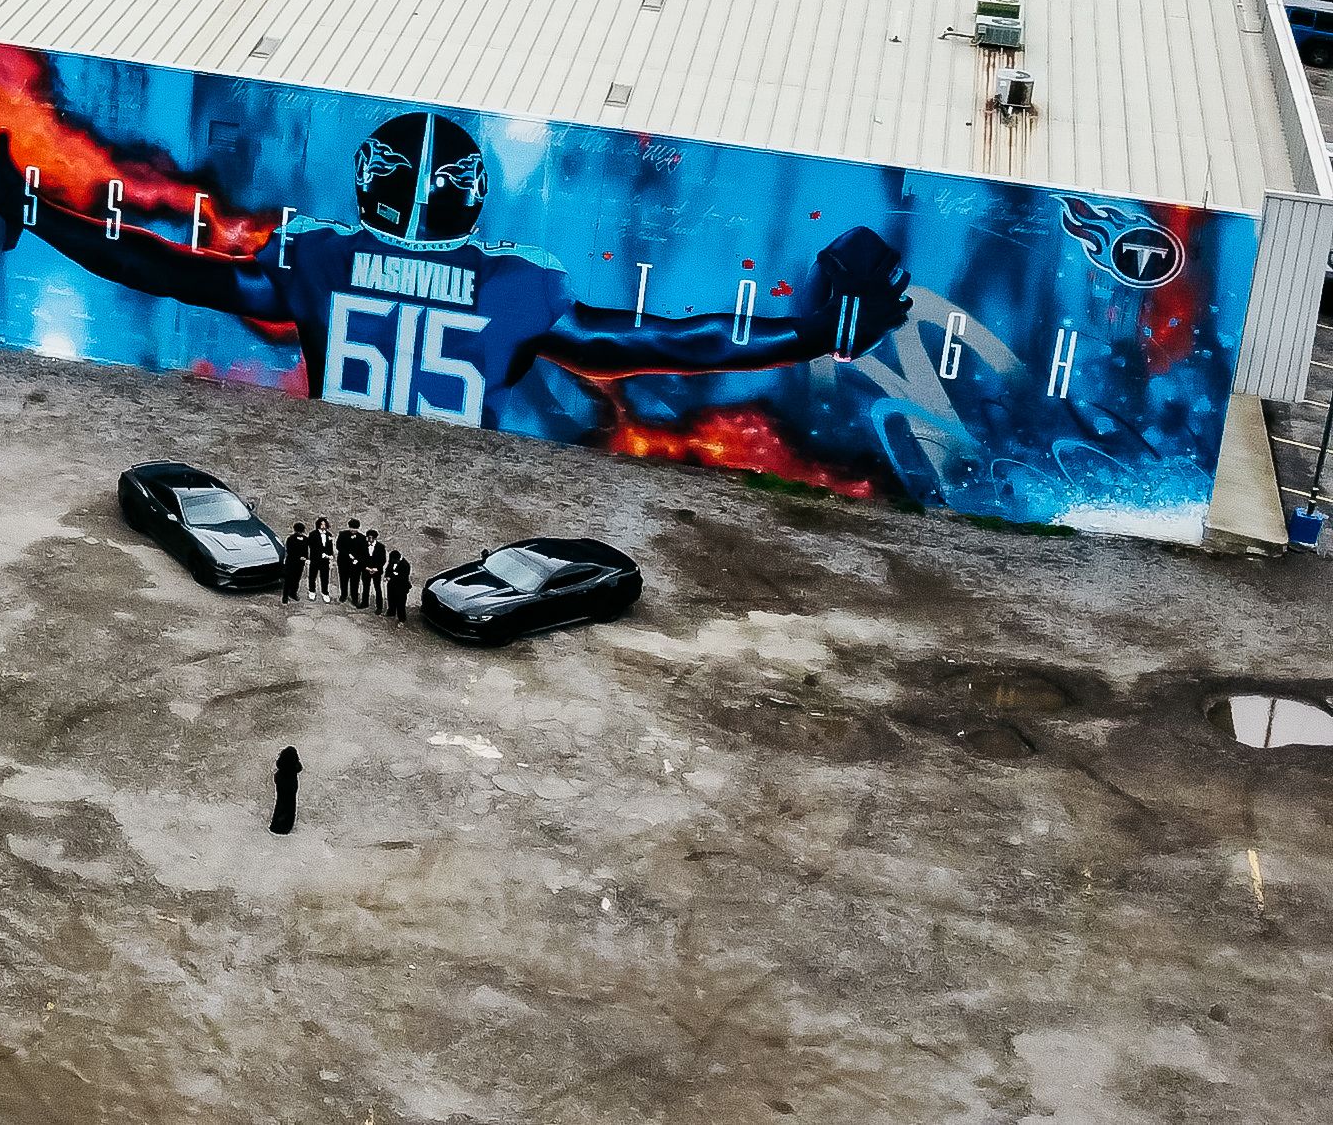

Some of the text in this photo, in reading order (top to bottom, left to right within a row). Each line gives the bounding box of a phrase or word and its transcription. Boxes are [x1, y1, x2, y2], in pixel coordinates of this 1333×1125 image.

[351, 252, 475, 305] NASHVILLE
[634, 262, 1078, 400] TOUGH
[322, 291, 492, 428] 615
